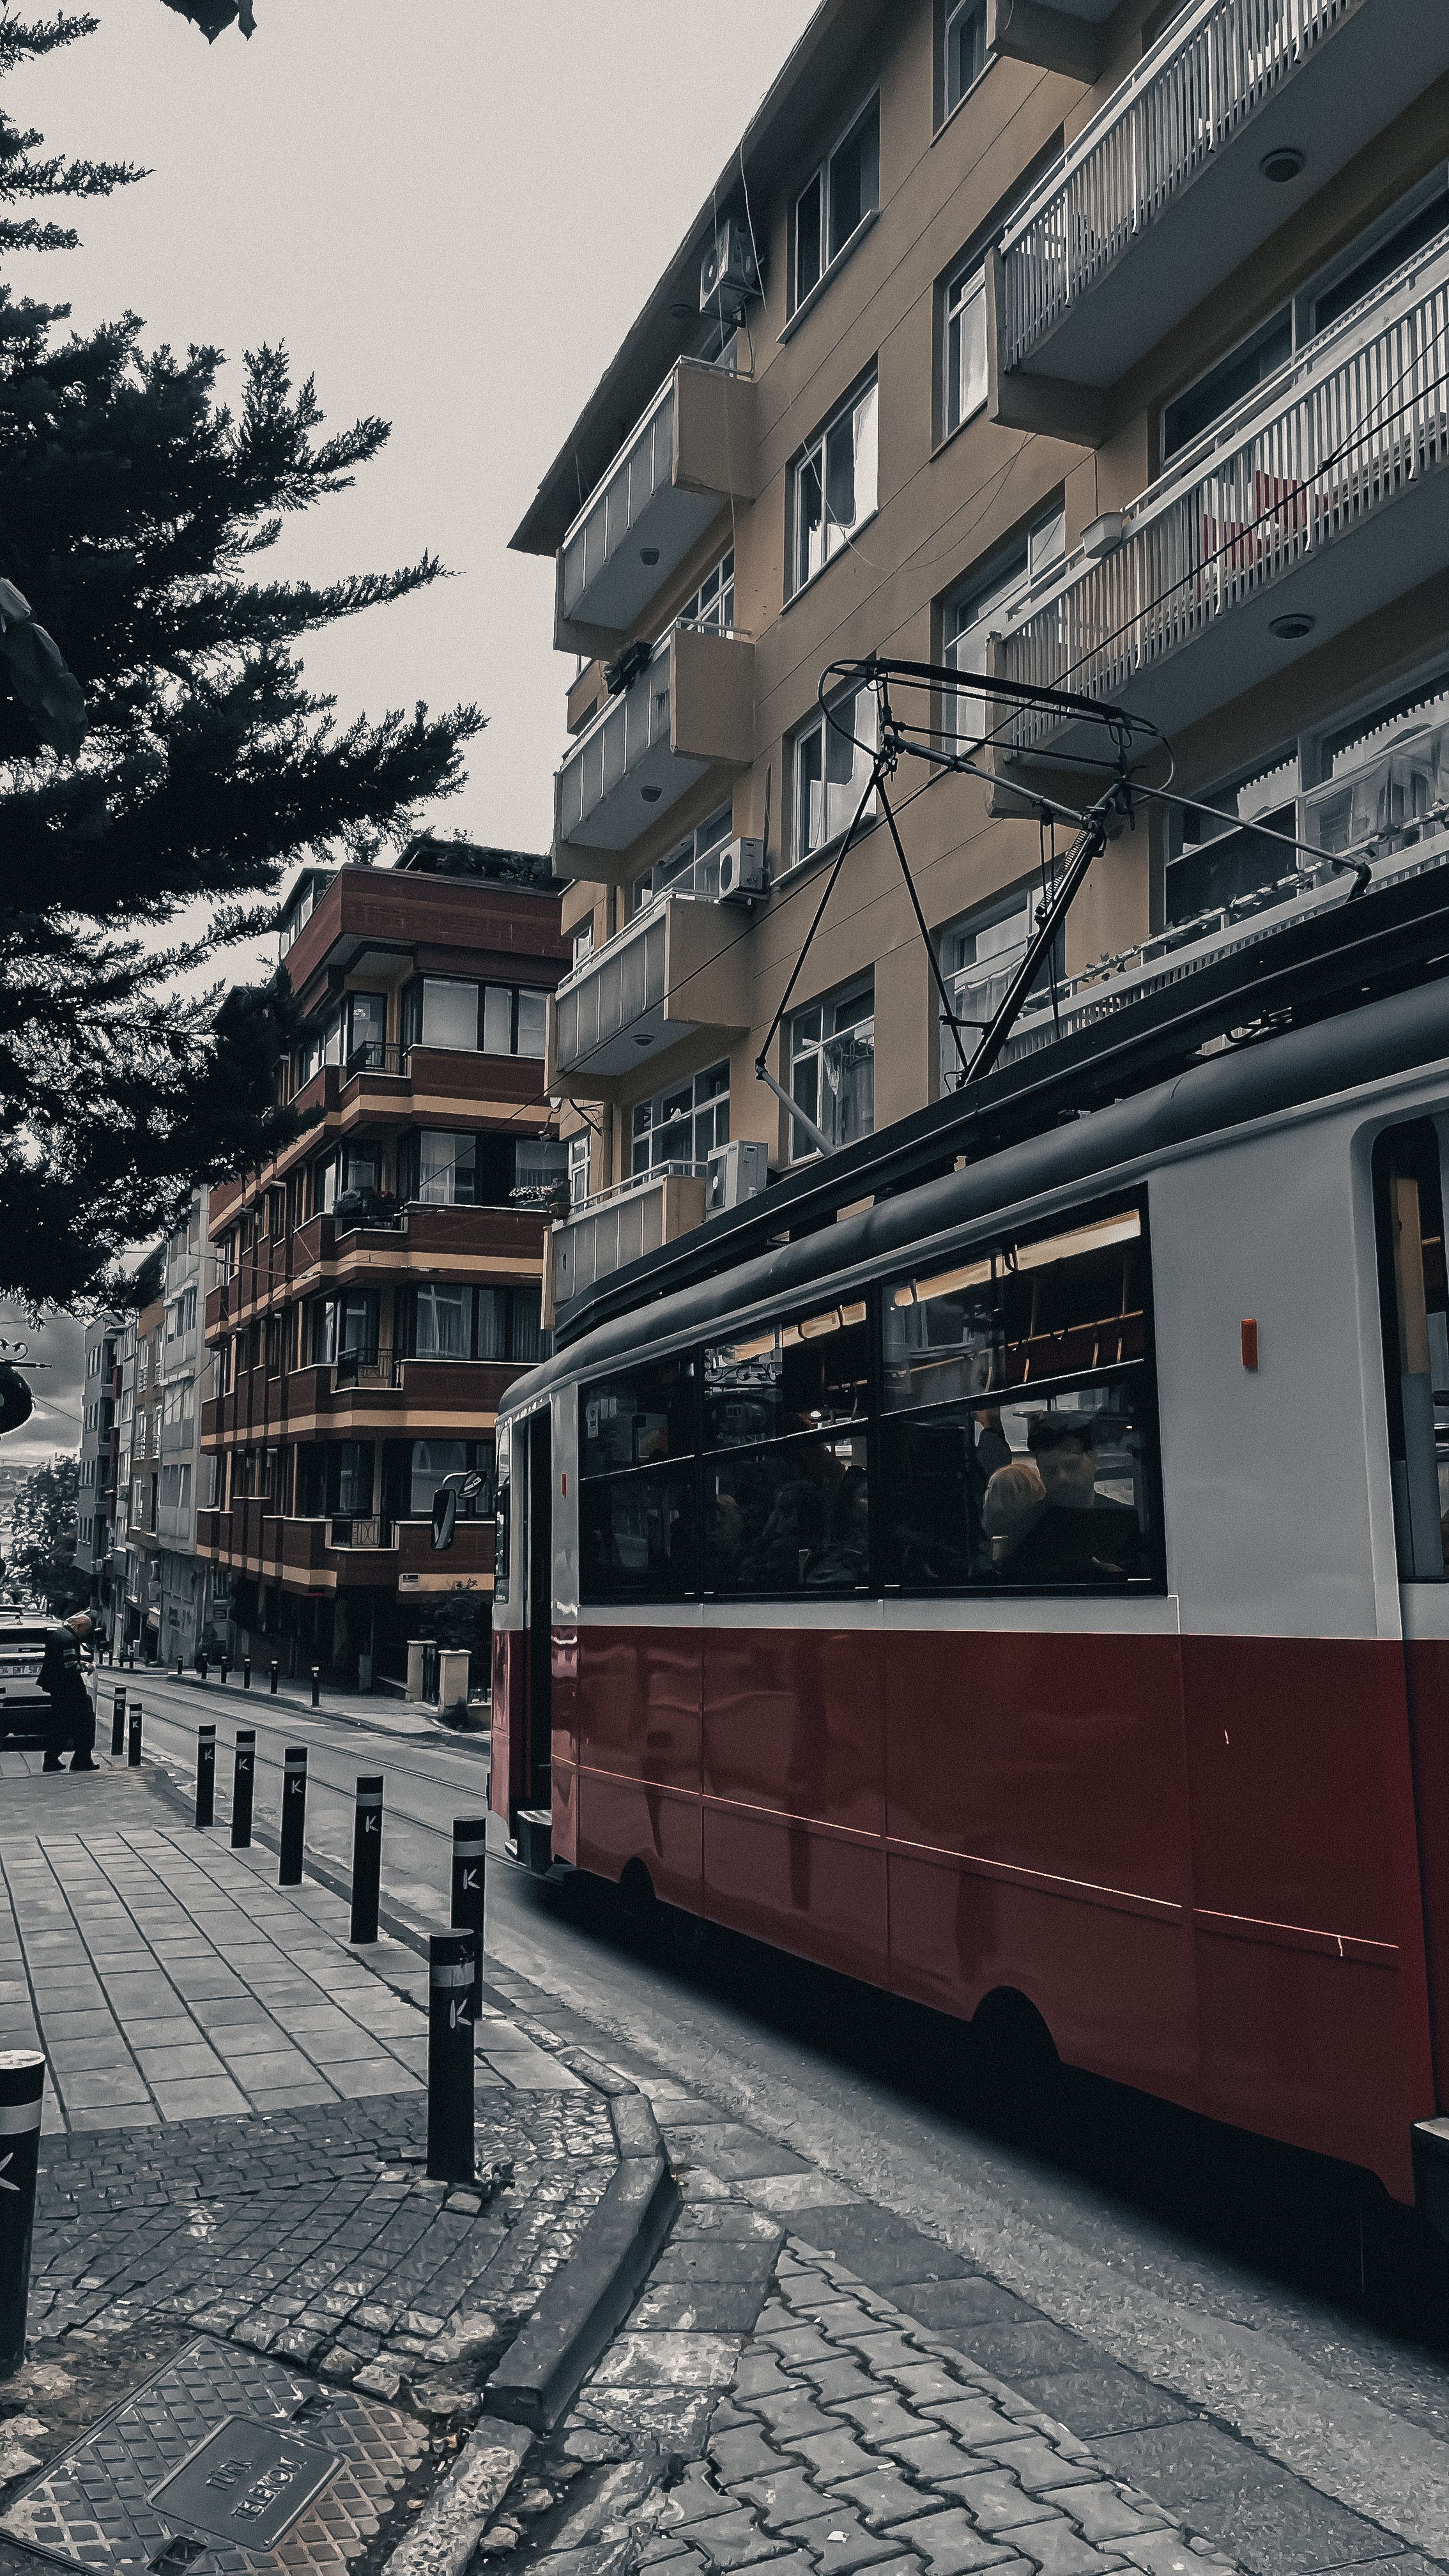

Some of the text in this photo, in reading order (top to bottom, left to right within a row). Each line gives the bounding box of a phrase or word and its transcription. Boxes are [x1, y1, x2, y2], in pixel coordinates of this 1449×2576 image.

[204, 1749, 213, 1760] K
[238, 1758, 250, 1770] K
[291, 1779, 303, 1794] K
[365, 1815, 379, 1832] K
[463, 1868, 480, 1890] K
[450, 1998, 472, 2029] K
[230, 2456, 308, 2522] TELEKOM
